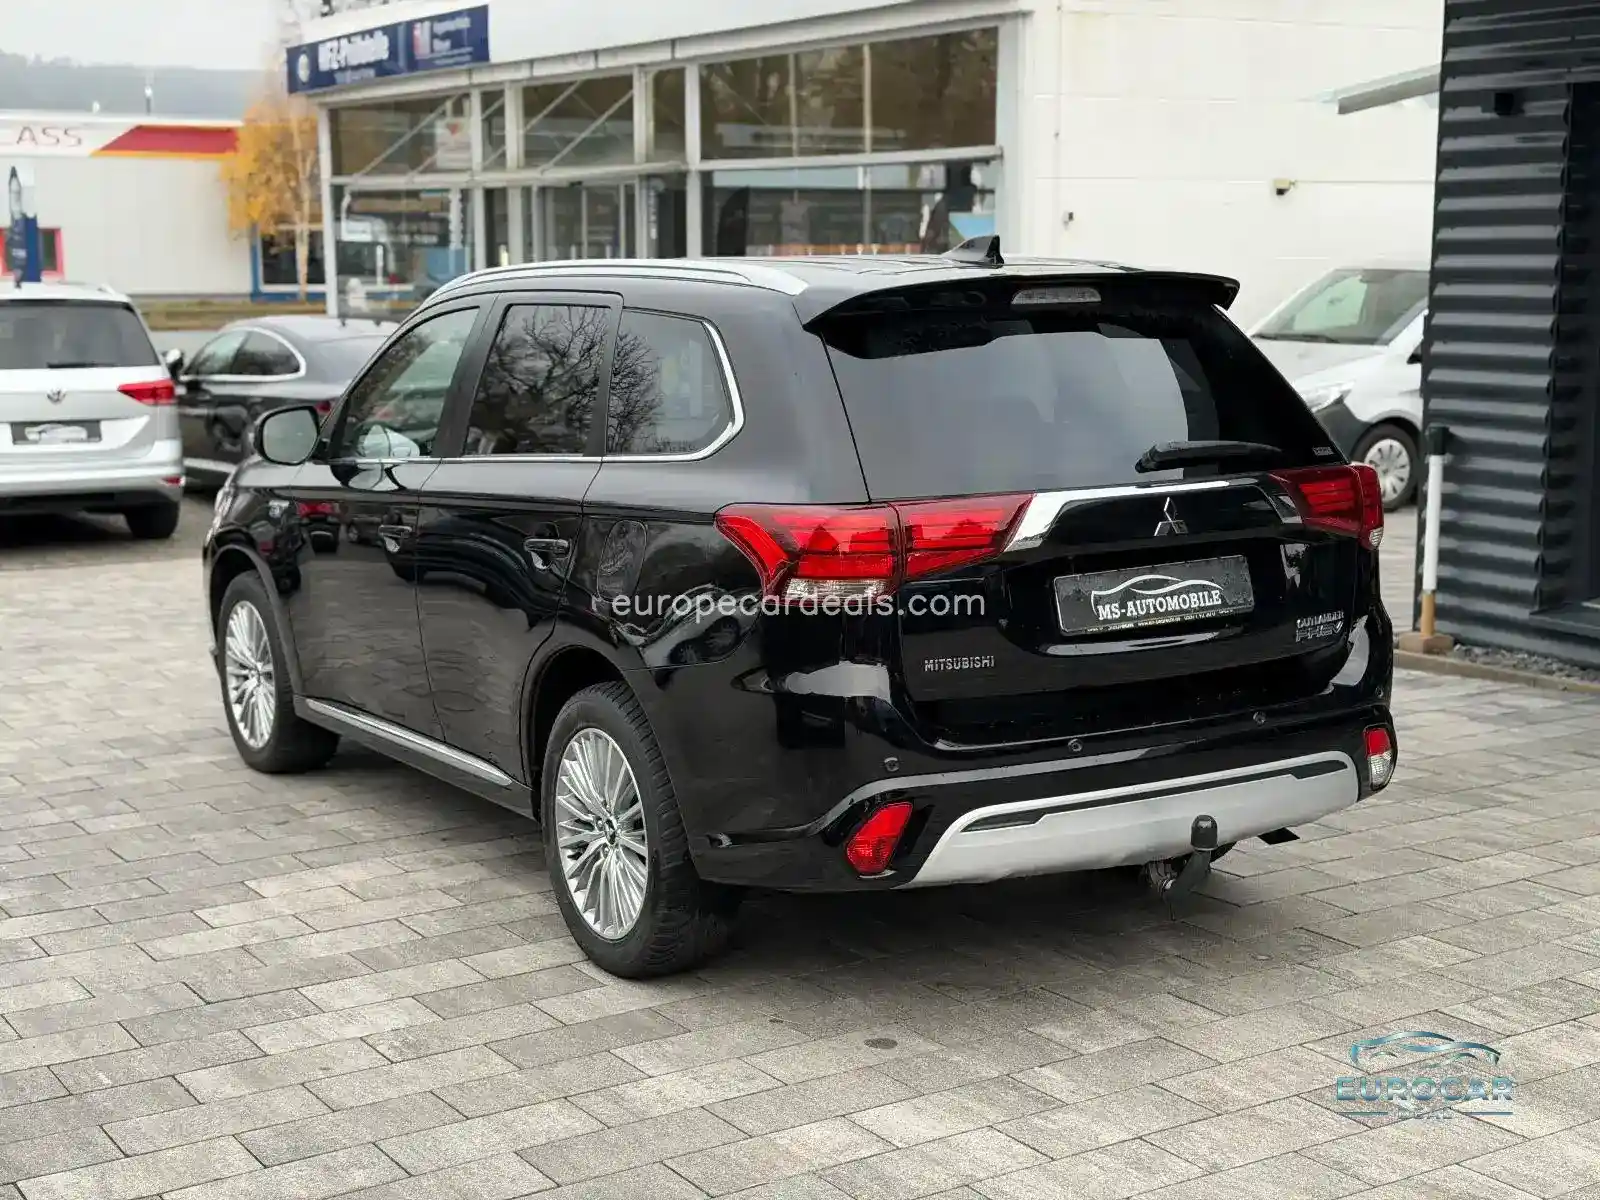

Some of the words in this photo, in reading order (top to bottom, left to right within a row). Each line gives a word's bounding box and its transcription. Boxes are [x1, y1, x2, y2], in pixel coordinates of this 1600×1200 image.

[0, 126, 82, 147] ASS
[1098, 590, 1222, 620] MS-AUTOMOBILE
[924, 655, 995, 672] MITSUBISHI
